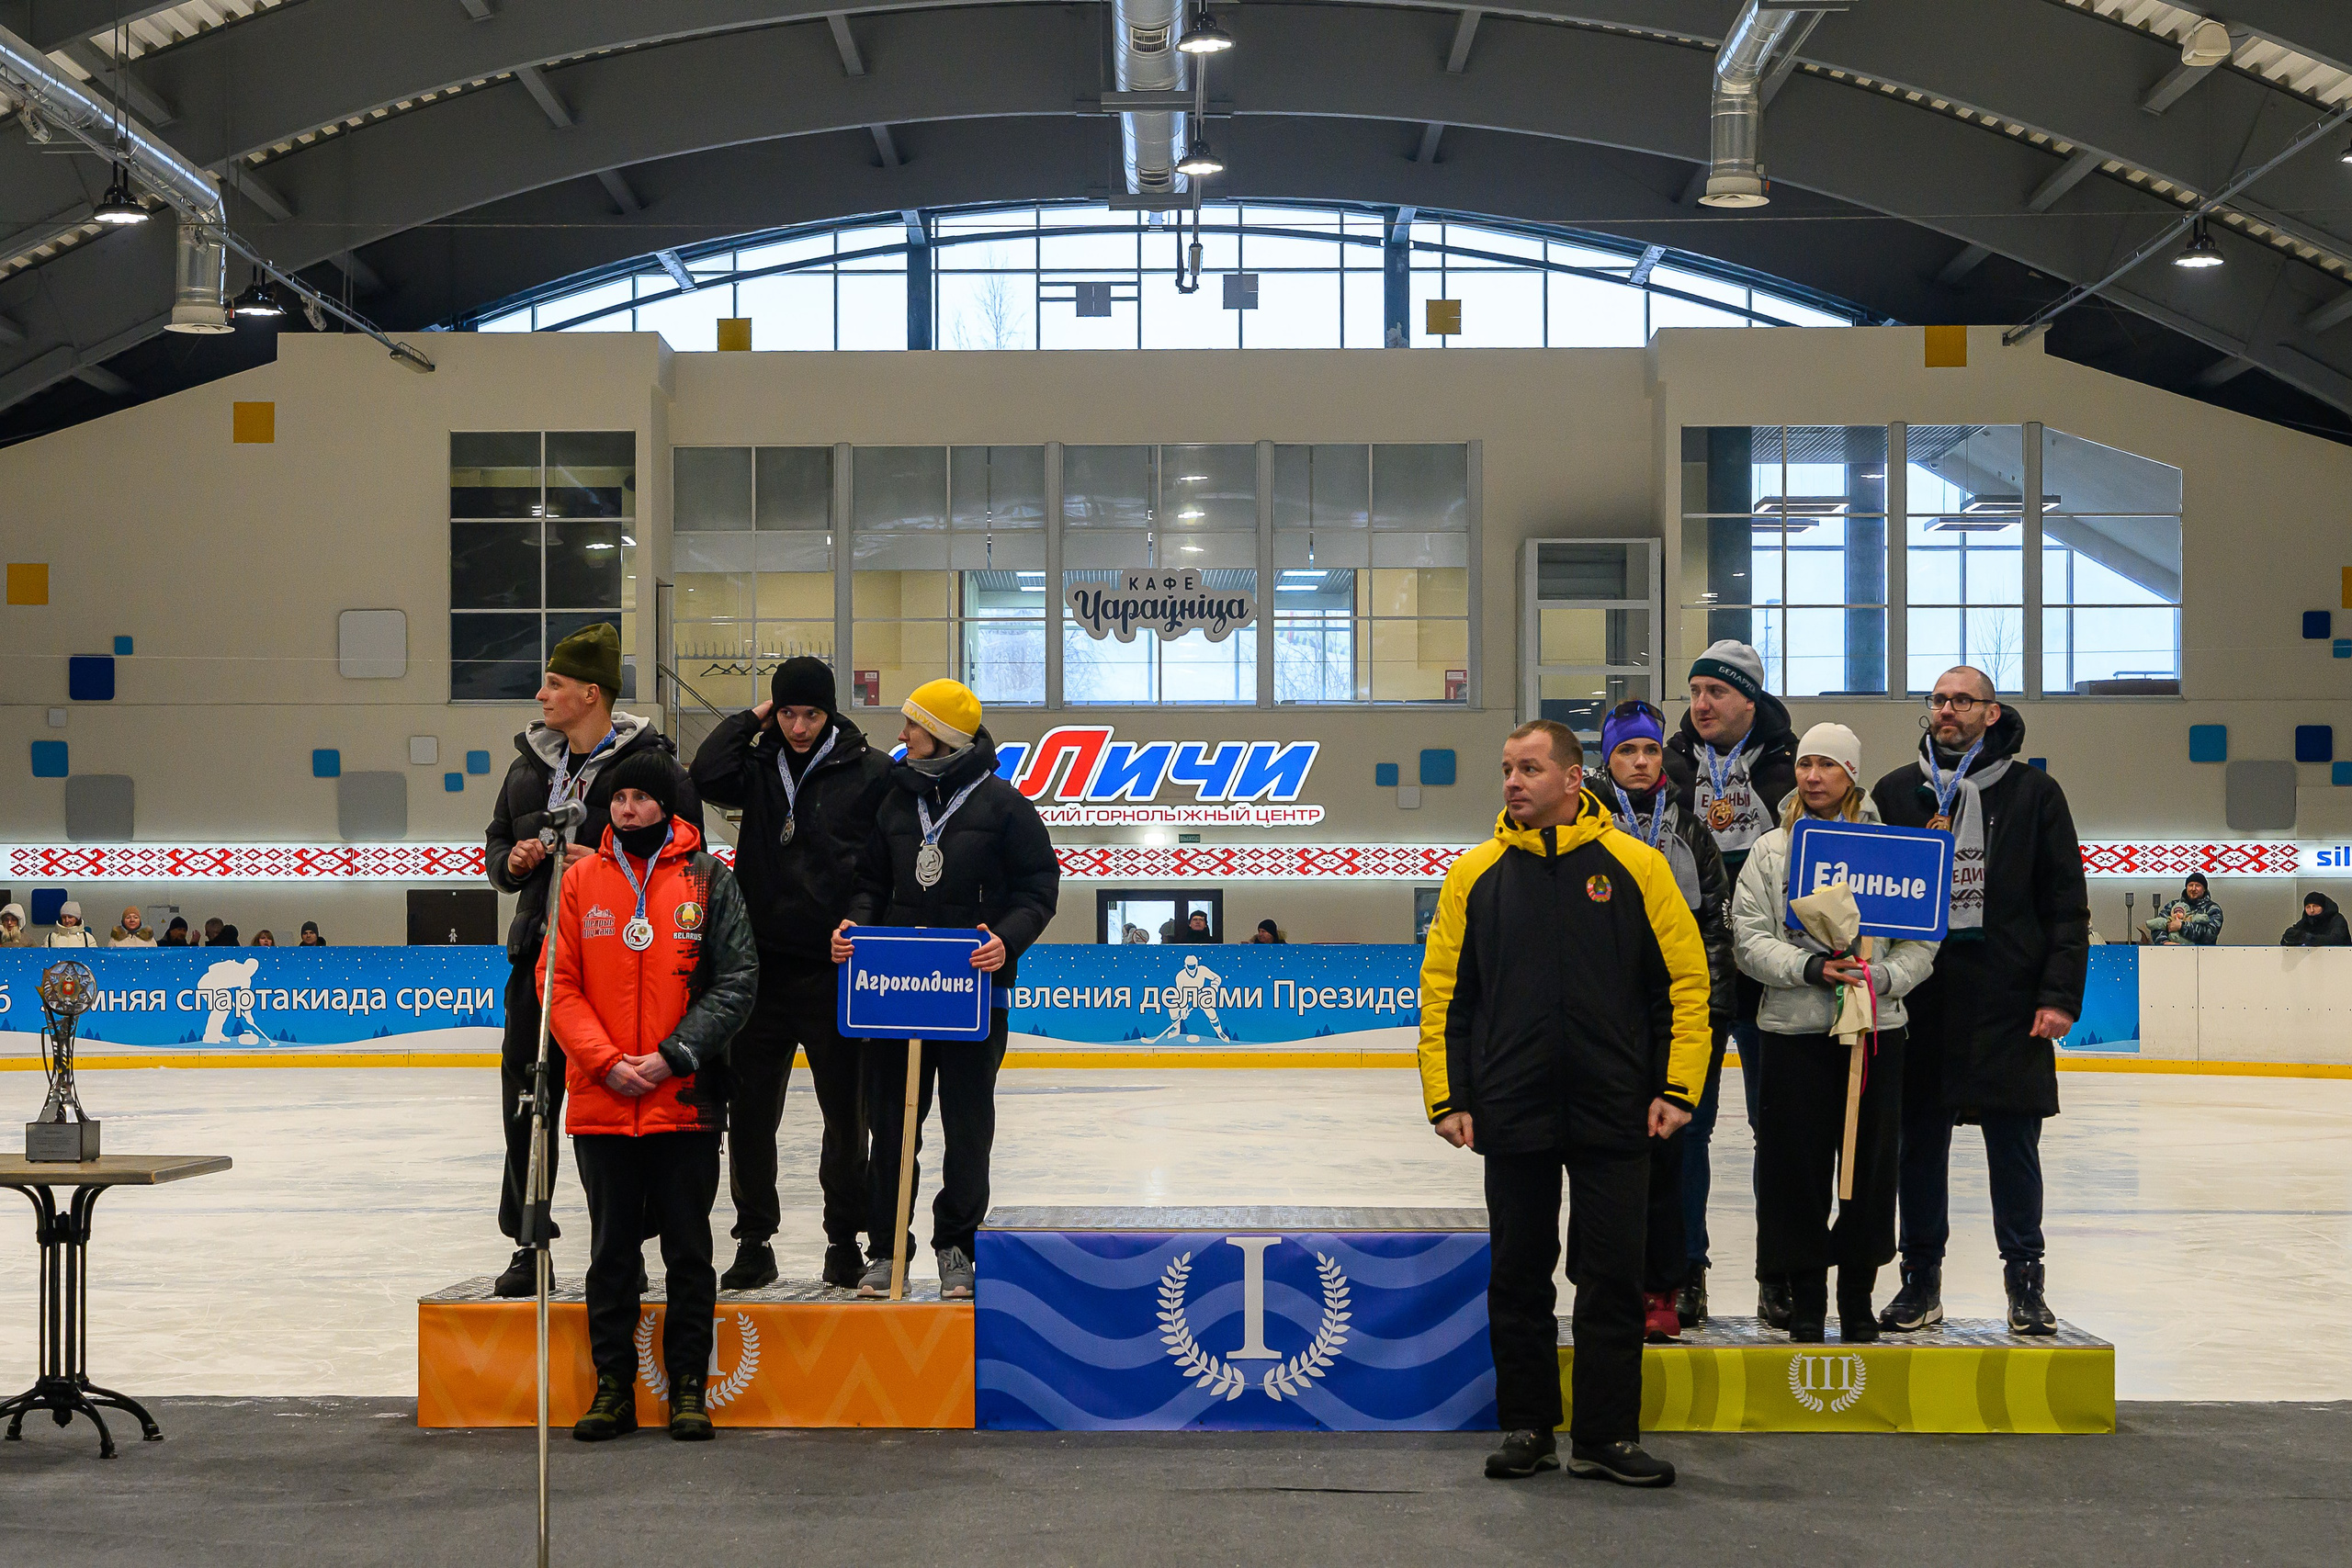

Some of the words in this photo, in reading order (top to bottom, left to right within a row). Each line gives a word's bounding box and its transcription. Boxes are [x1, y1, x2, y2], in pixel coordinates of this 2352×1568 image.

[1128, 576, 1193, 591] КАФЕ
[1073, 589, 1250, 634] Чараўніца
[1086, 807, 1250, 821] ГОРНОЛЫЖНЫЙ
[1256, 809, 1320, 823] ЦЕНТР
[2316, 846, 2350, 866] sil
[1813, 861, 1928, 900] Единые
[673, 931, 702, 941] BELARUS
[854, 969, 975, 997] Агрохолдинг
[175, 987, 387, 1018] спартакиада
[395, 987, 494, 1017] среди
[1139, 986, 1263, 1014] делами
[1801, 1356, 1854, 1390] III
